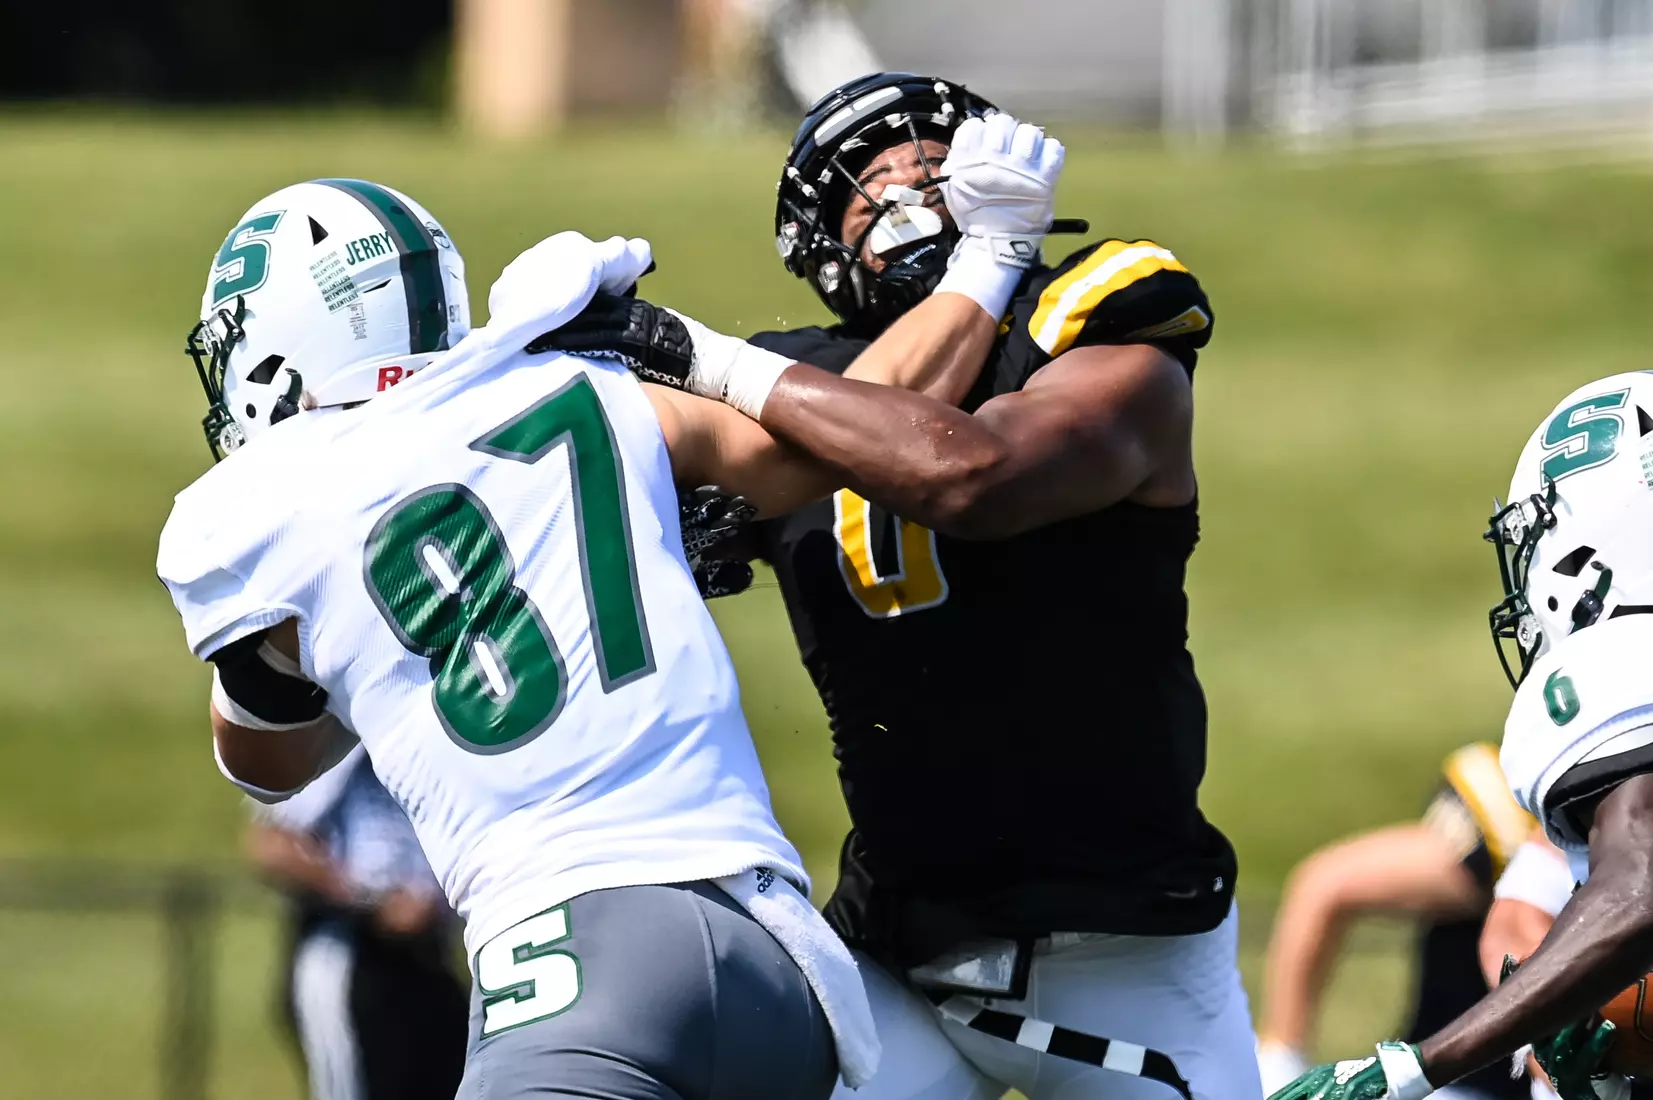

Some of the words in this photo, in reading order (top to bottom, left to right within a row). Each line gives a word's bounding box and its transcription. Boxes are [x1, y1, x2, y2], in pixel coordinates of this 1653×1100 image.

[211, 209, 288, 311] S
[345, 230, 394, 266] JERRY
[328, 291, 359, 312] RELENTLESS
[1540, 387, 1632, 489] S
[362, 371, 657, 756] 87
[1542, 665, 1582, 727] 6
[476, 901, 584, 1040] S
